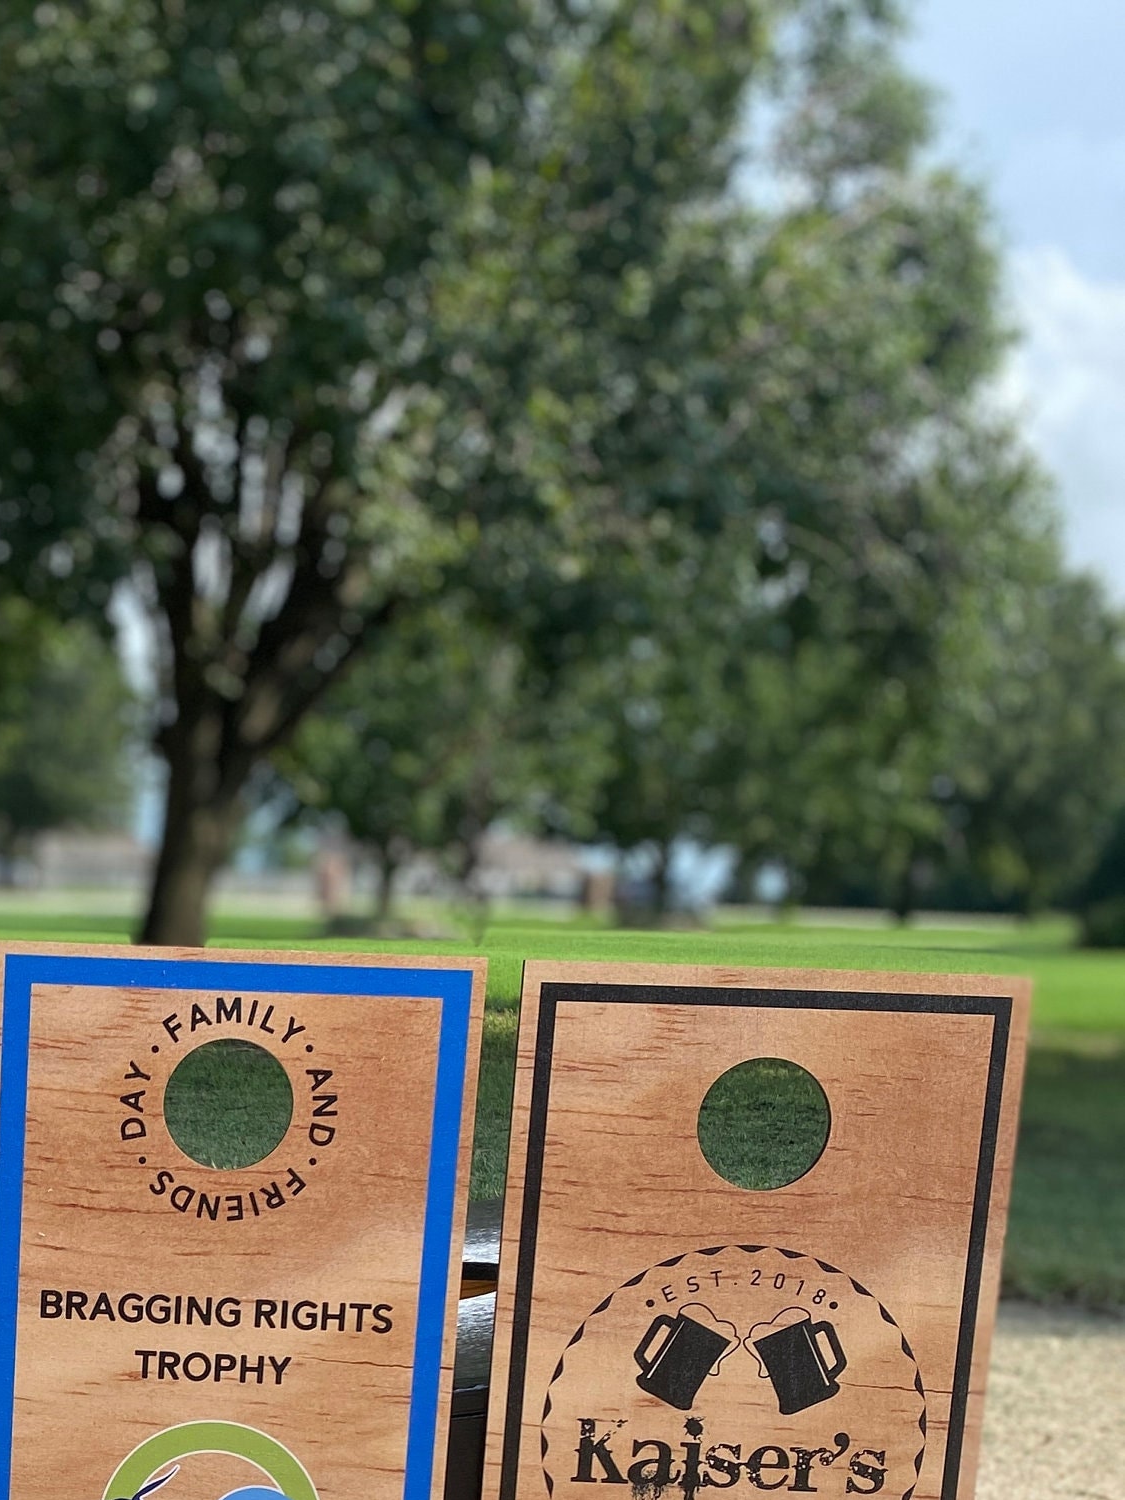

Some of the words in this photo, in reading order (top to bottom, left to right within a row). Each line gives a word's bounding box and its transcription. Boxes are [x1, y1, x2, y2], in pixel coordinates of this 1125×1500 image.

[162, 997, 306, 1044] FAMILY
[120, 1060, 151, 1140] DAY
[305, 1068, 338, 1147] AND
[148, 1167, 307, 1221] FRIENDS
[40, 1290, 241, 1327] BRAGGING
[254, 1299, 393, 1334] RIGHTS
[135, 1349, 292, 1385] TROPHY
